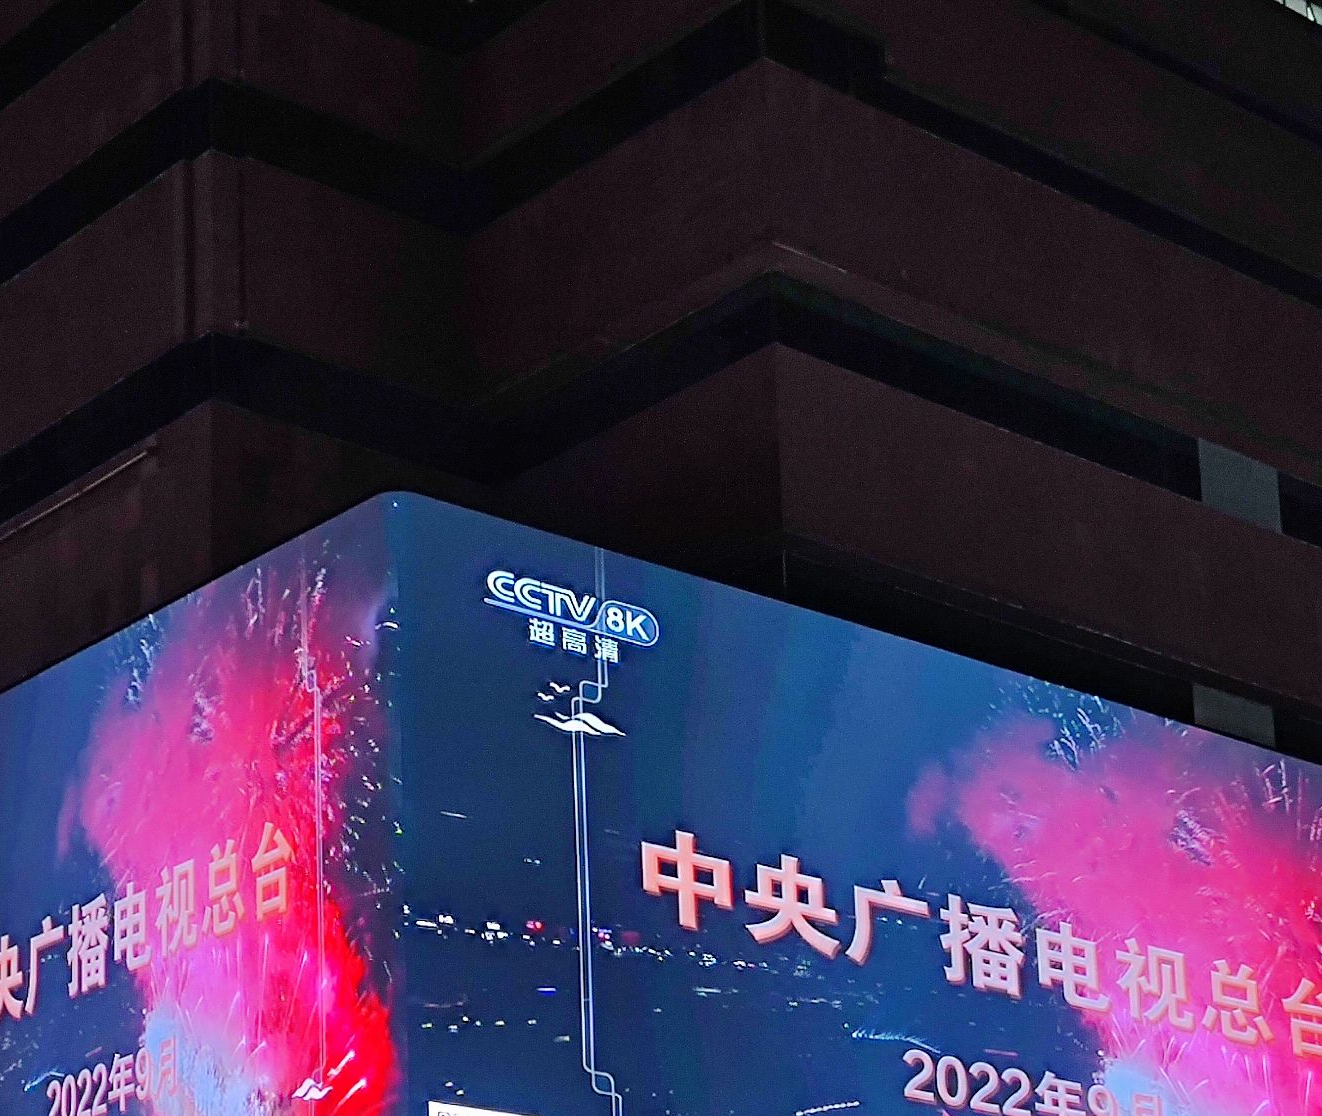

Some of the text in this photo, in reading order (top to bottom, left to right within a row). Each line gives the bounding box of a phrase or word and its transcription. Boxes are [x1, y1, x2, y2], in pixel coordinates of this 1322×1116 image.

[487, 570, 650, 641] CCTV 8K
[529, 617, 619, 664] 超高清
